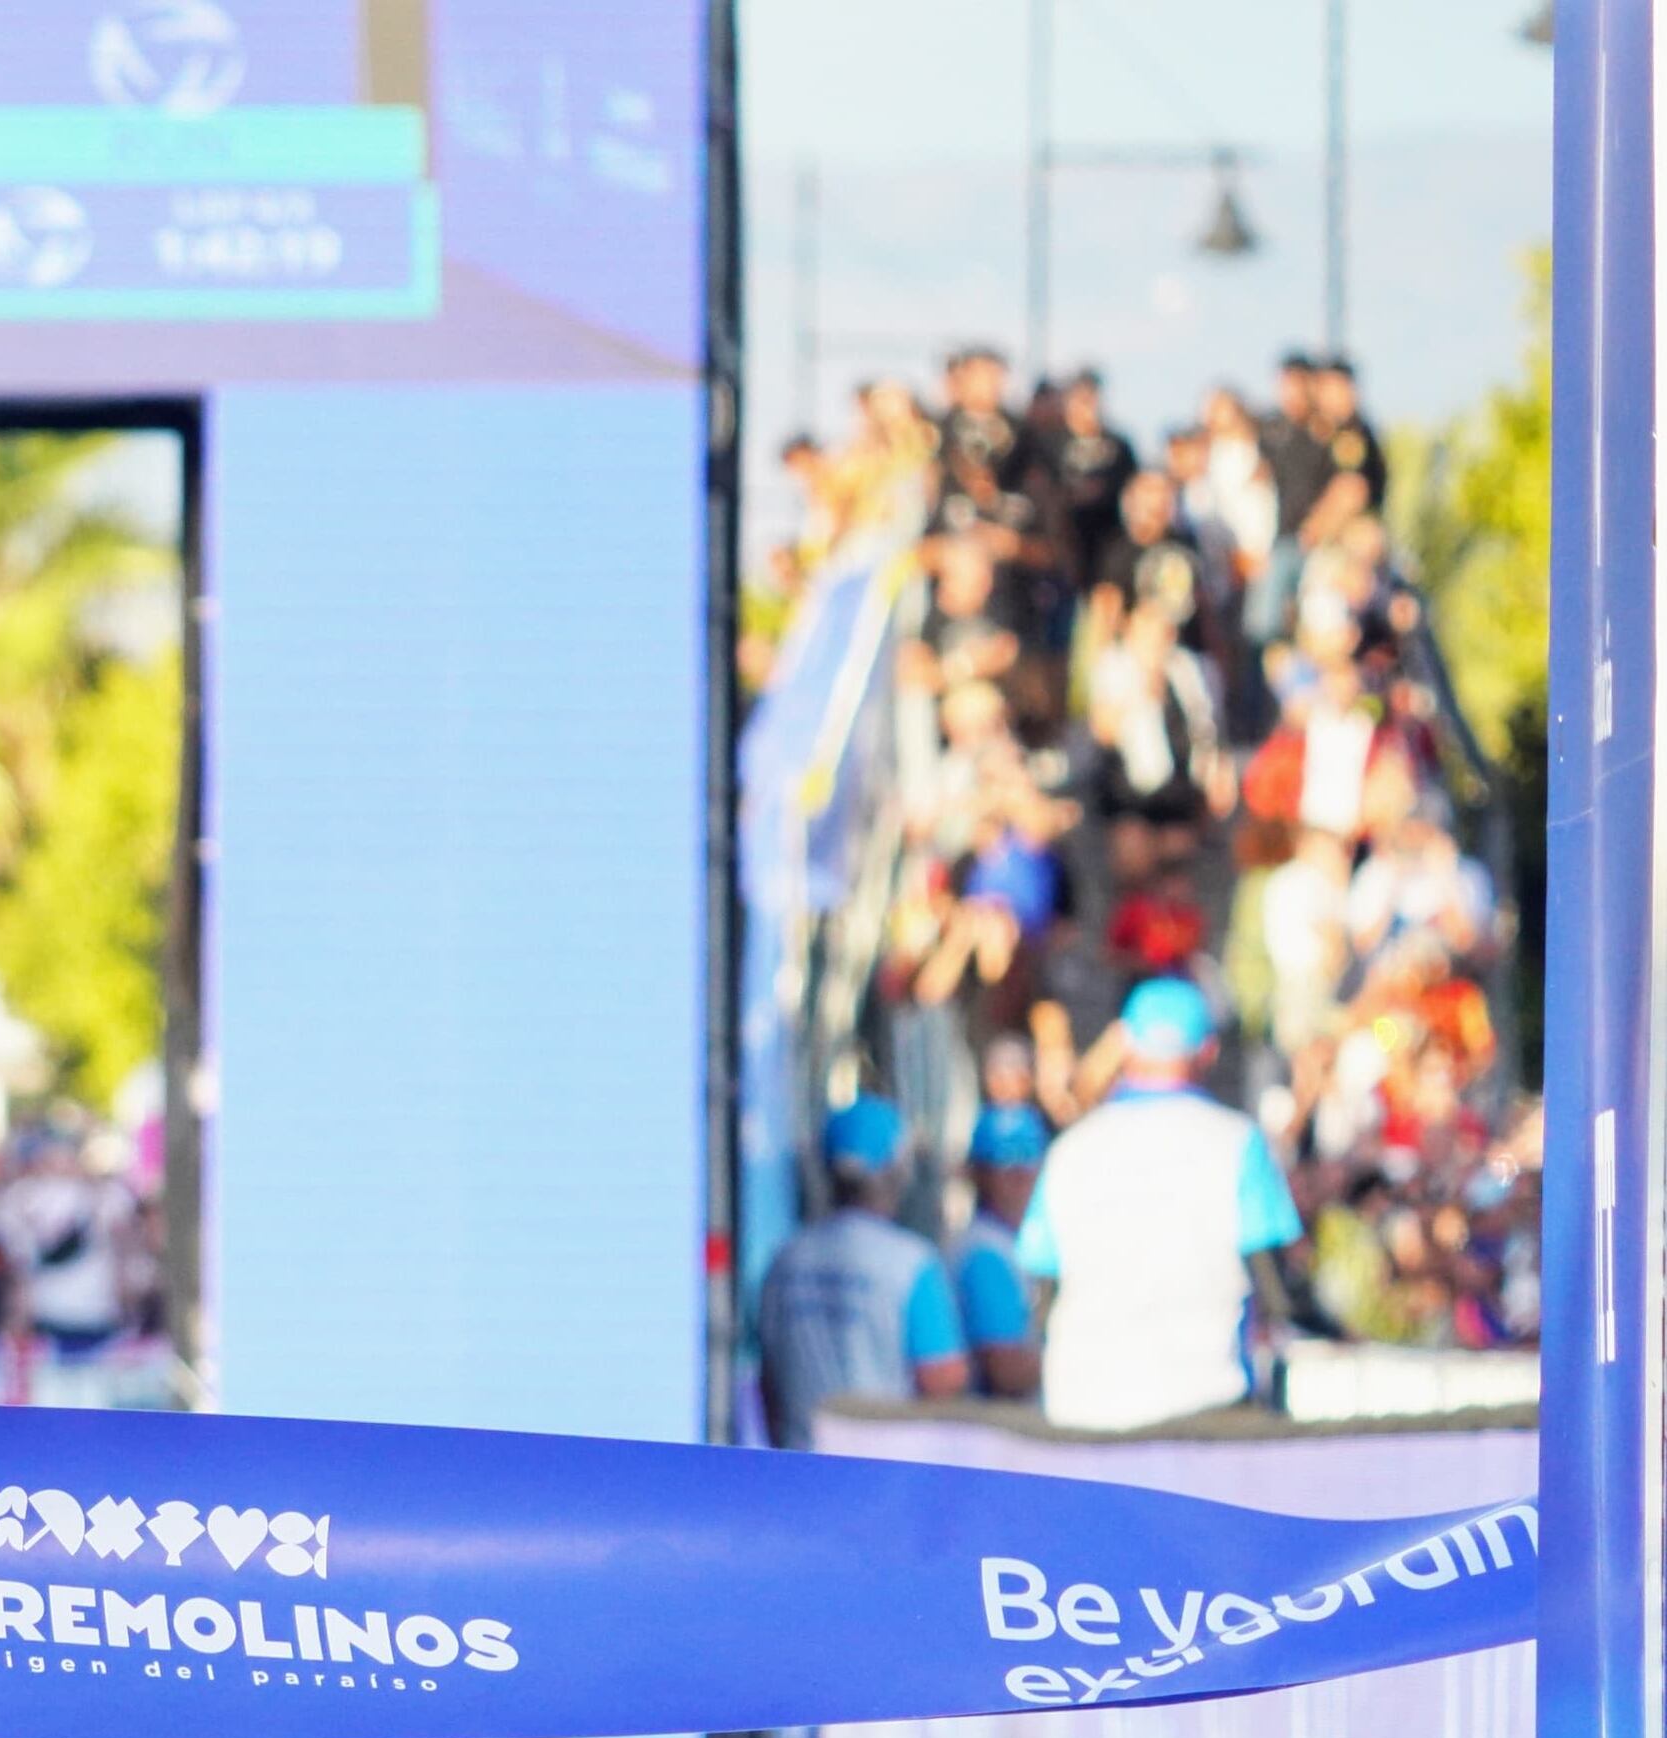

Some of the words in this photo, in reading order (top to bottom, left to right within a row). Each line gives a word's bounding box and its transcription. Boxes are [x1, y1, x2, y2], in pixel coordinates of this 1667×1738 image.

[980, 1557, 1121, 1646] Be
[144, 1659, 215, 1682] del
[252, 1666, 439, 1693] paraíso
